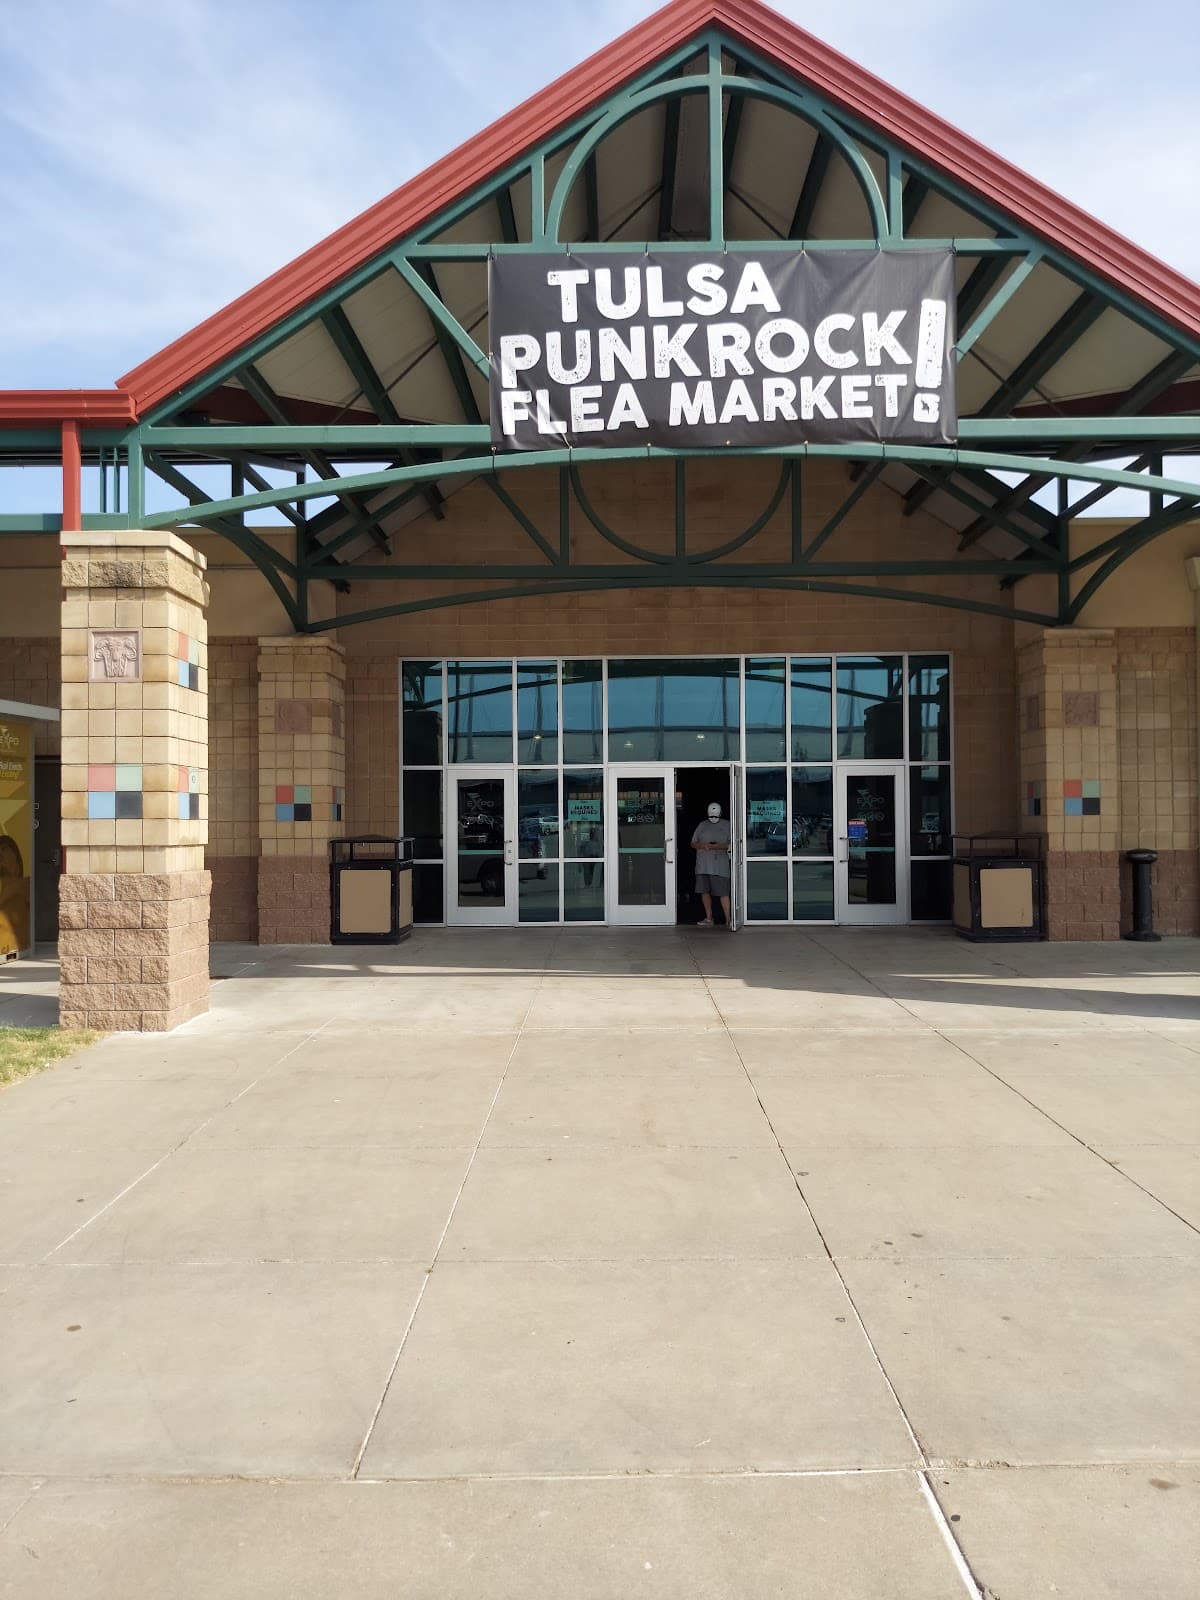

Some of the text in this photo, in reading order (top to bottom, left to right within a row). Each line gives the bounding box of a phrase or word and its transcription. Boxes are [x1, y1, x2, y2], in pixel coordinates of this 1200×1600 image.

[547, 261, 782, 323] TULSA
[500, 310, 913, 389] PUNKROCK
[501, 374, 908, 436] FLEA MARKET
